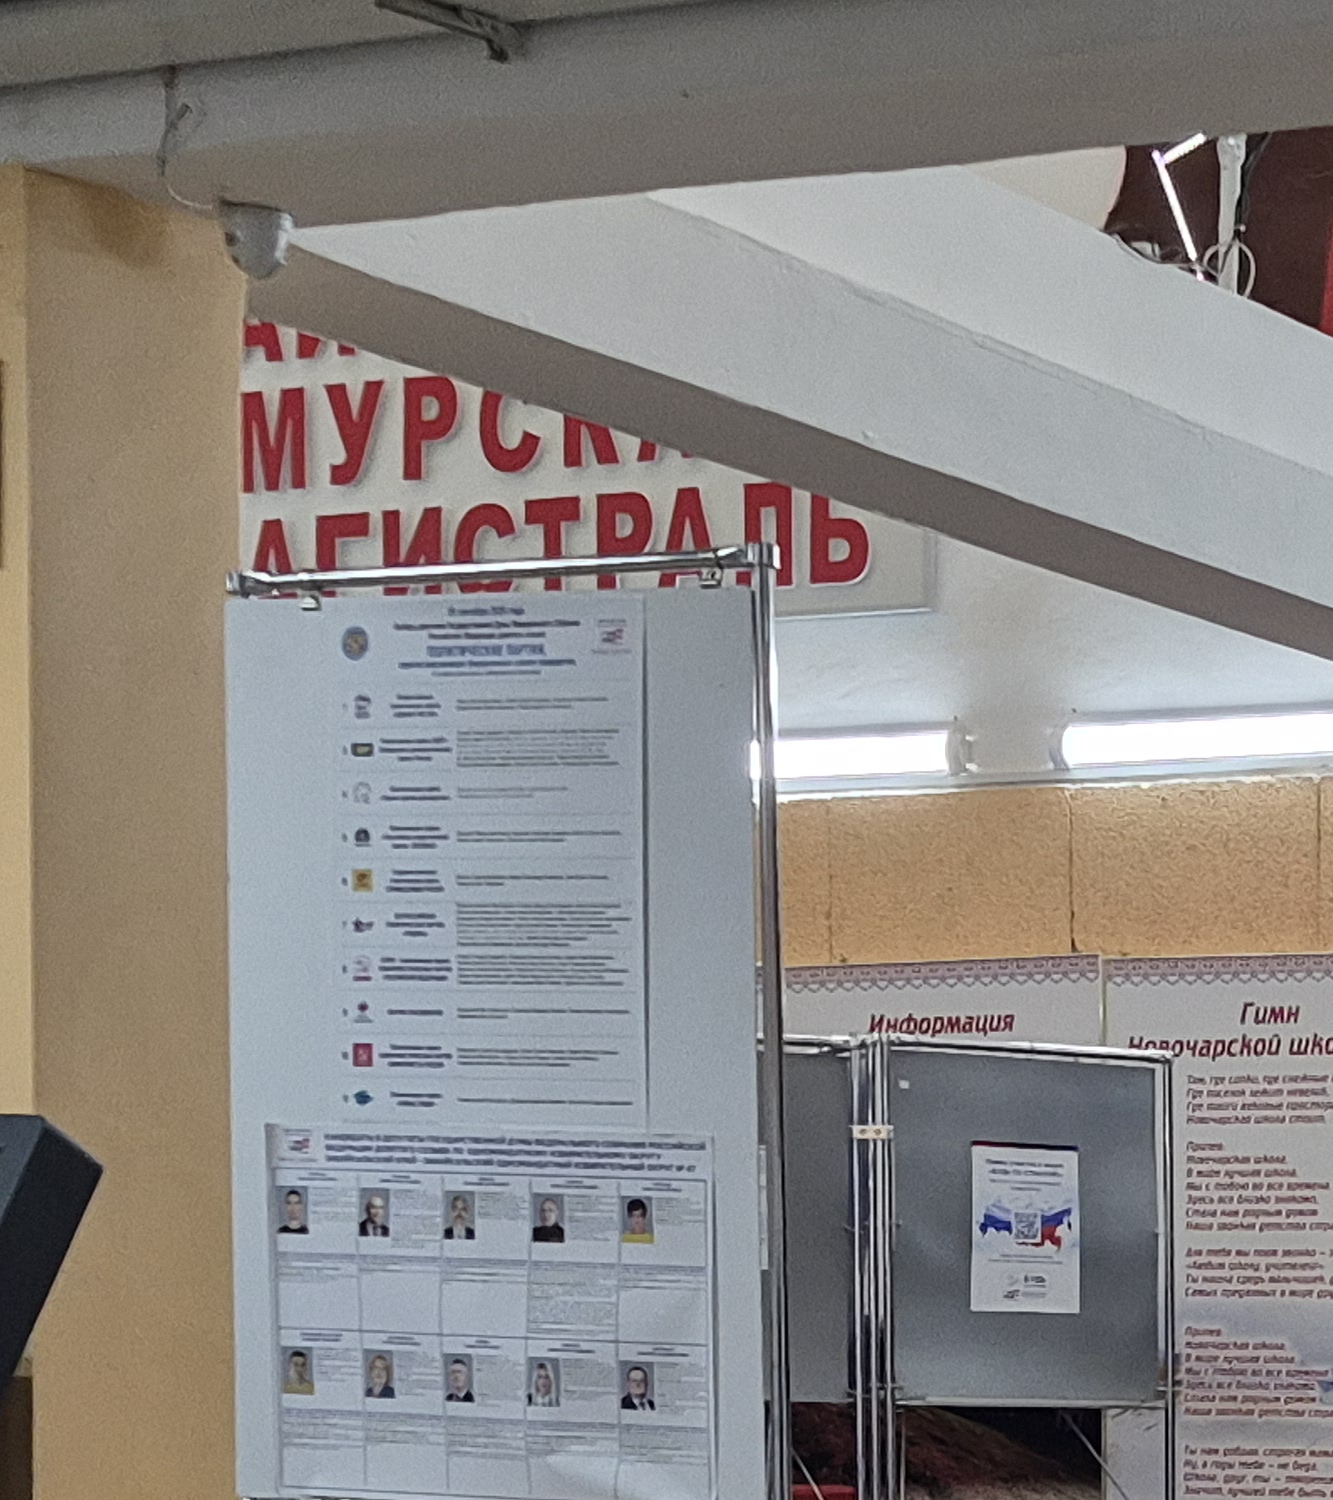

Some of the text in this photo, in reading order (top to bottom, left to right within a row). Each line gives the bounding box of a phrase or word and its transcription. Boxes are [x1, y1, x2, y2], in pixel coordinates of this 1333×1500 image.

[241, 375, 694, 492] МУРСК
[869, 1011, 1015, 1037] Информация
[1239, 1002, 1300, 1026] Гимн
